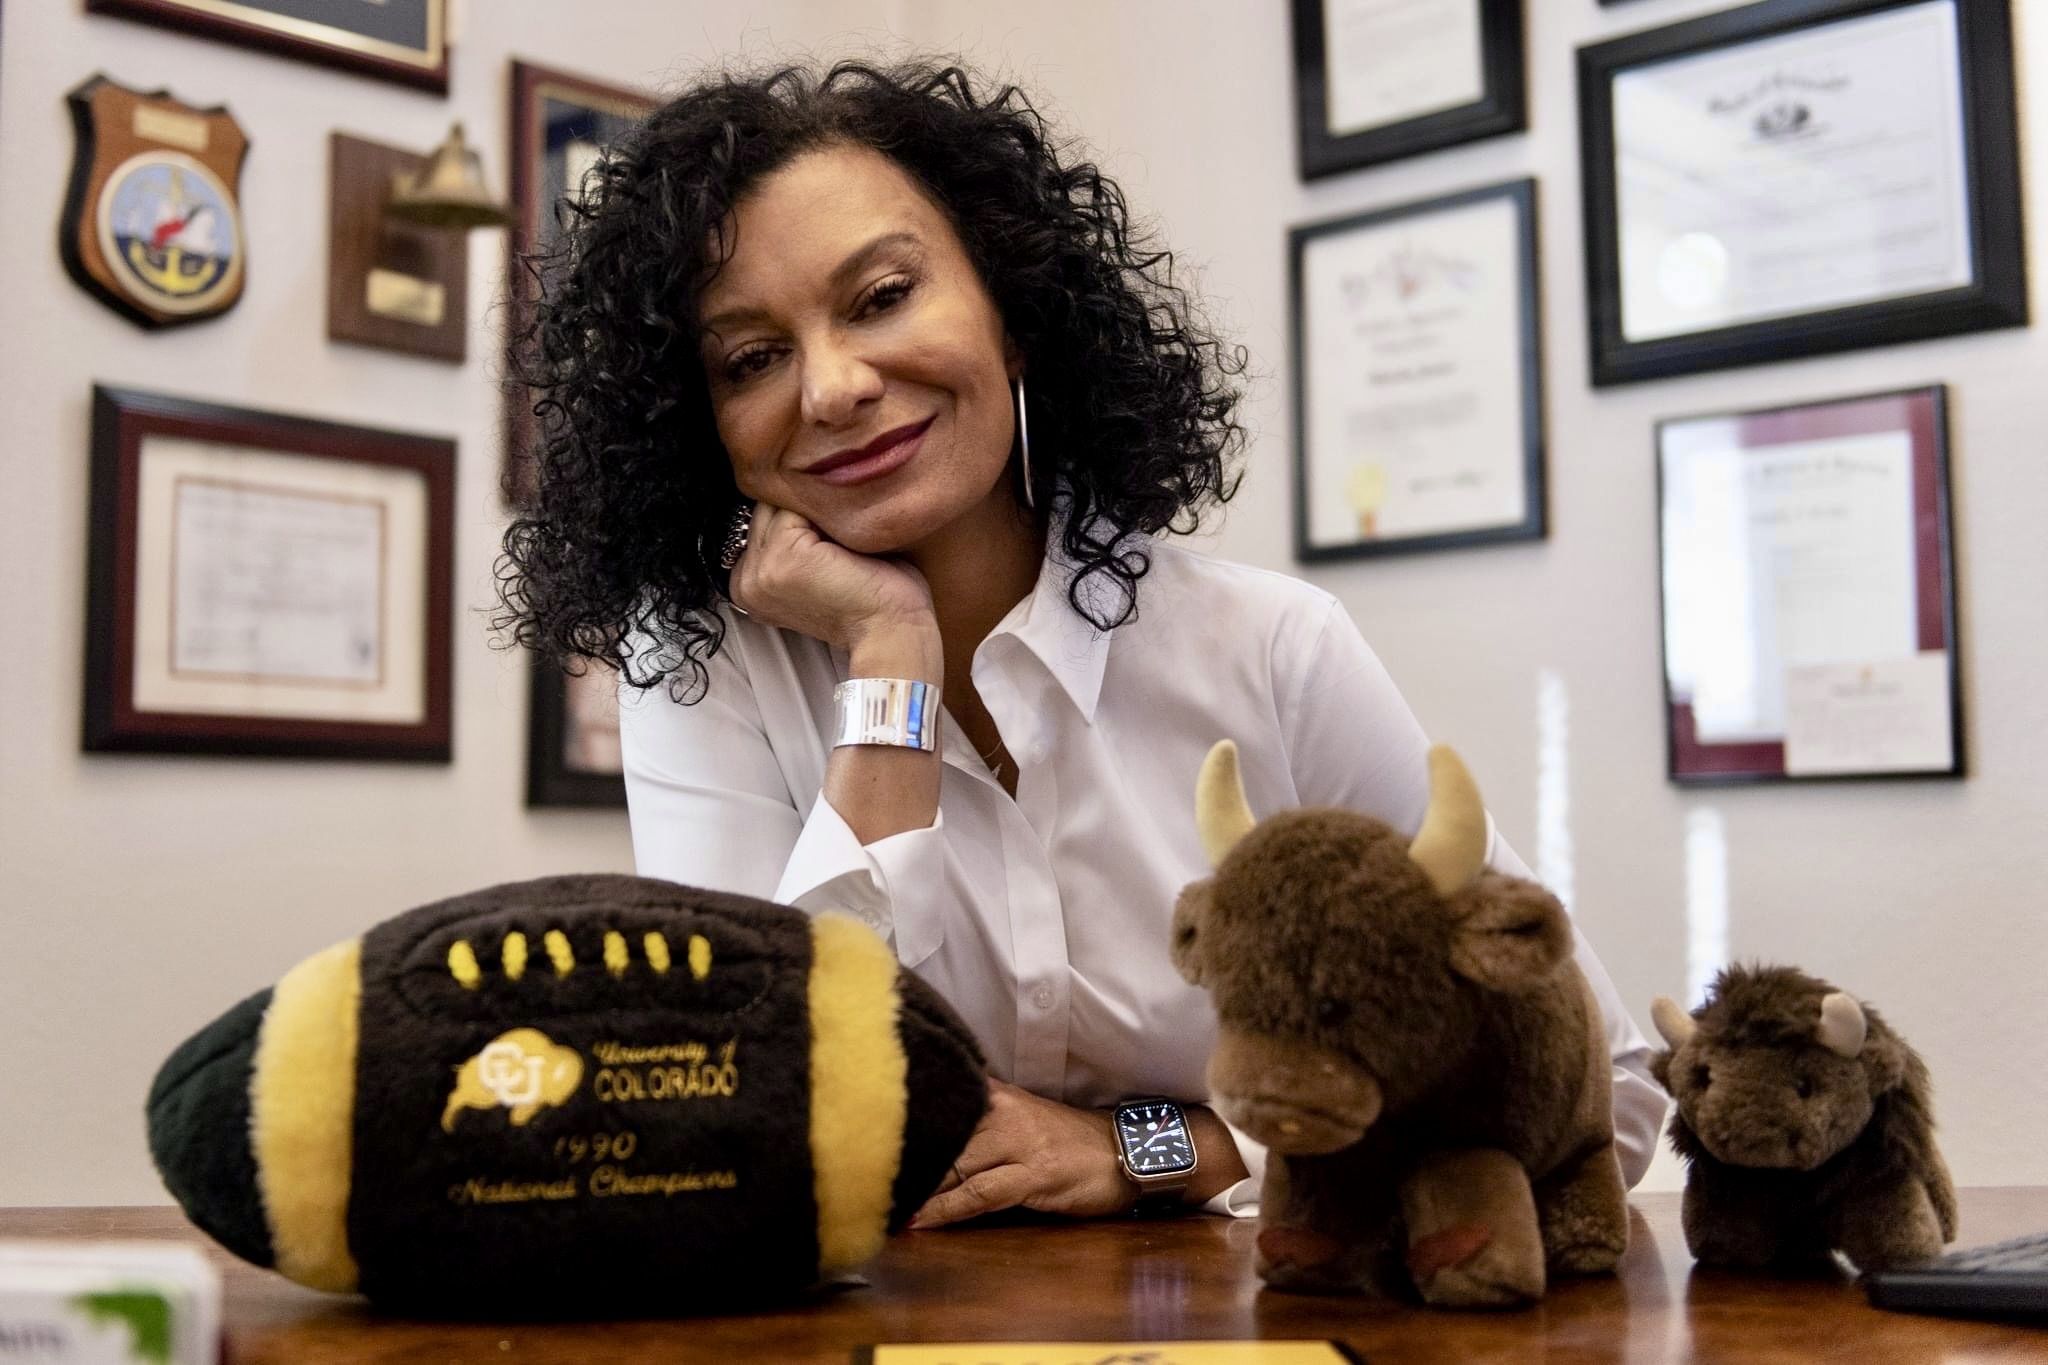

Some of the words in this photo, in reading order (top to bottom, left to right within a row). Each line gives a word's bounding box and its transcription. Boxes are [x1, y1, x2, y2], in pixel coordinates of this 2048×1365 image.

[592, 1040, 708, 1066] University
[478, 1041, 545, 1106] CU
[594, 1063, 739, 1102] COLORADO
[554, 1130, 637, 1164] 1990
[450, 1173, 577, 1204] National
[589, 1164, 737, 1197] Champions
